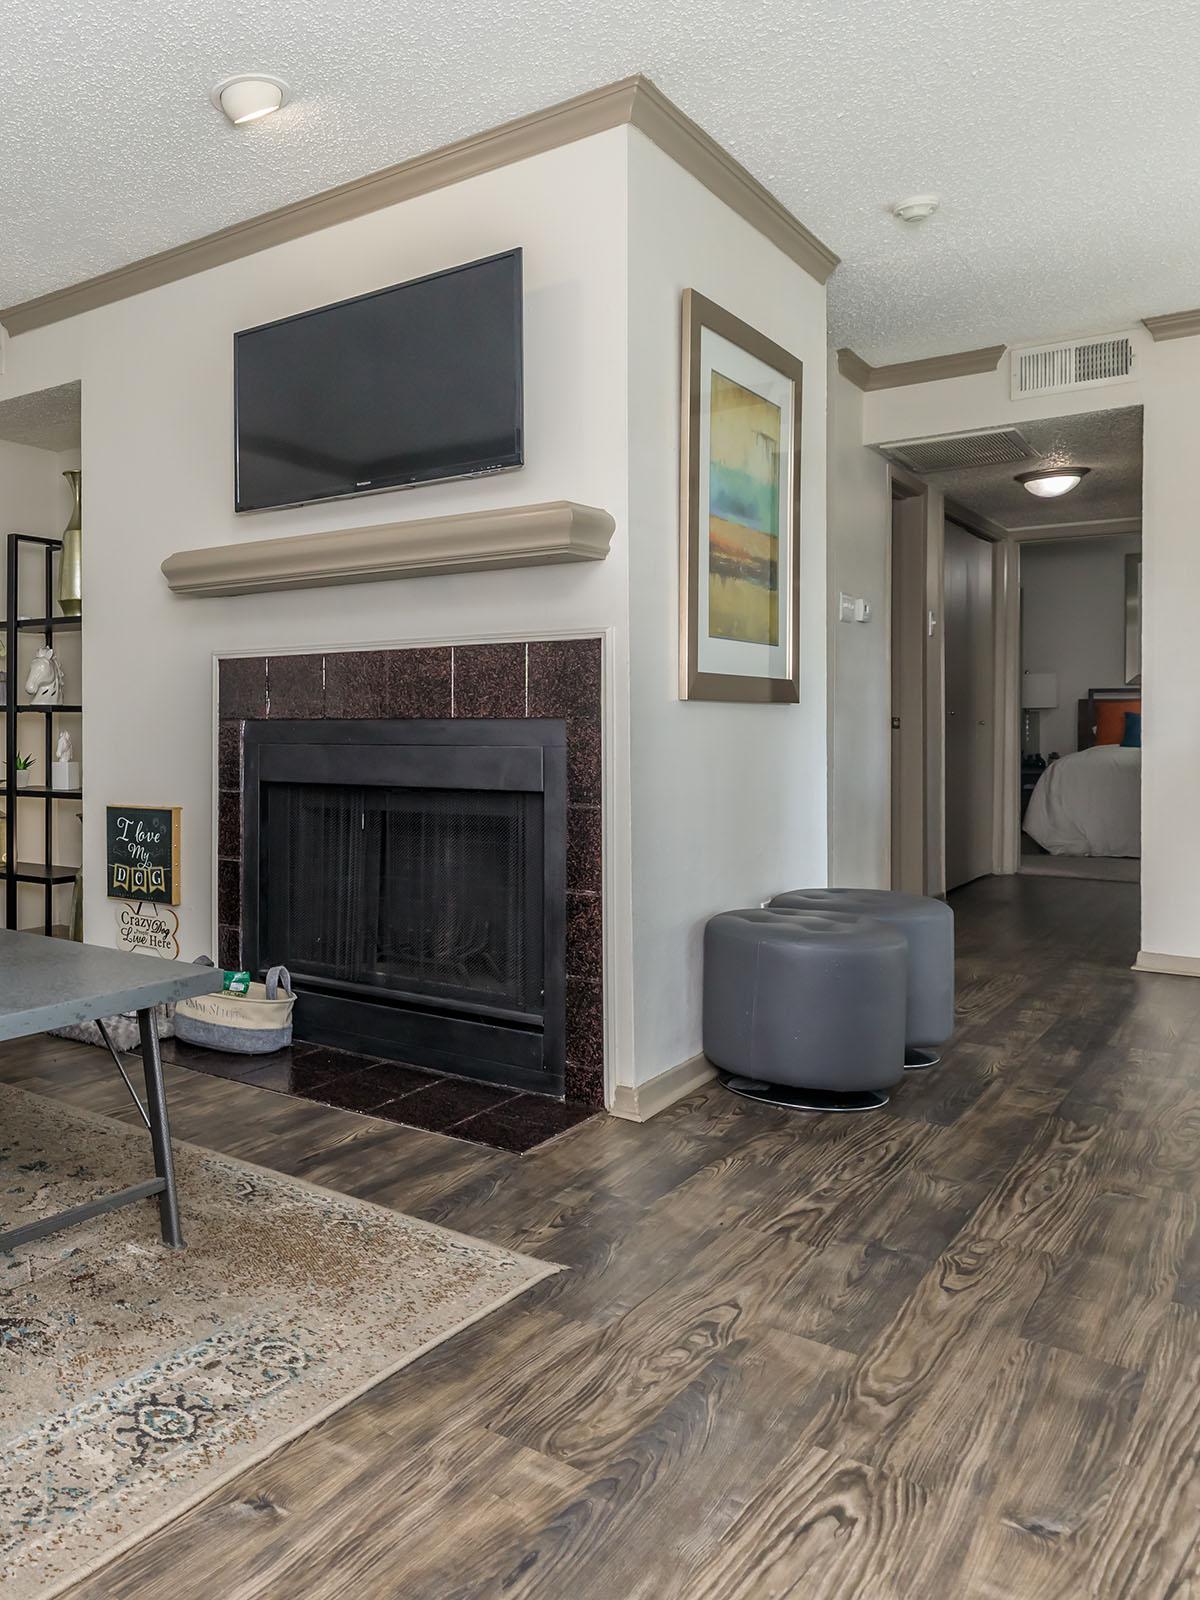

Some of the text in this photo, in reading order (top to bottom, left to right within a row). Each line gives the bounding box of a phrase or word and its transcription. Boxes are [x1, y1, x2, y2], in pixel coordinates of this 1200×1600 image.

[116, 817, 160, 843] I love
[128, 842, 152, 869] My
[117, 868, 161, 885] DOG
[121, 911, 170, 940] Crazy Dog
[121, 926, 147, 944] Live
[150, 935, 171, 949] Here
